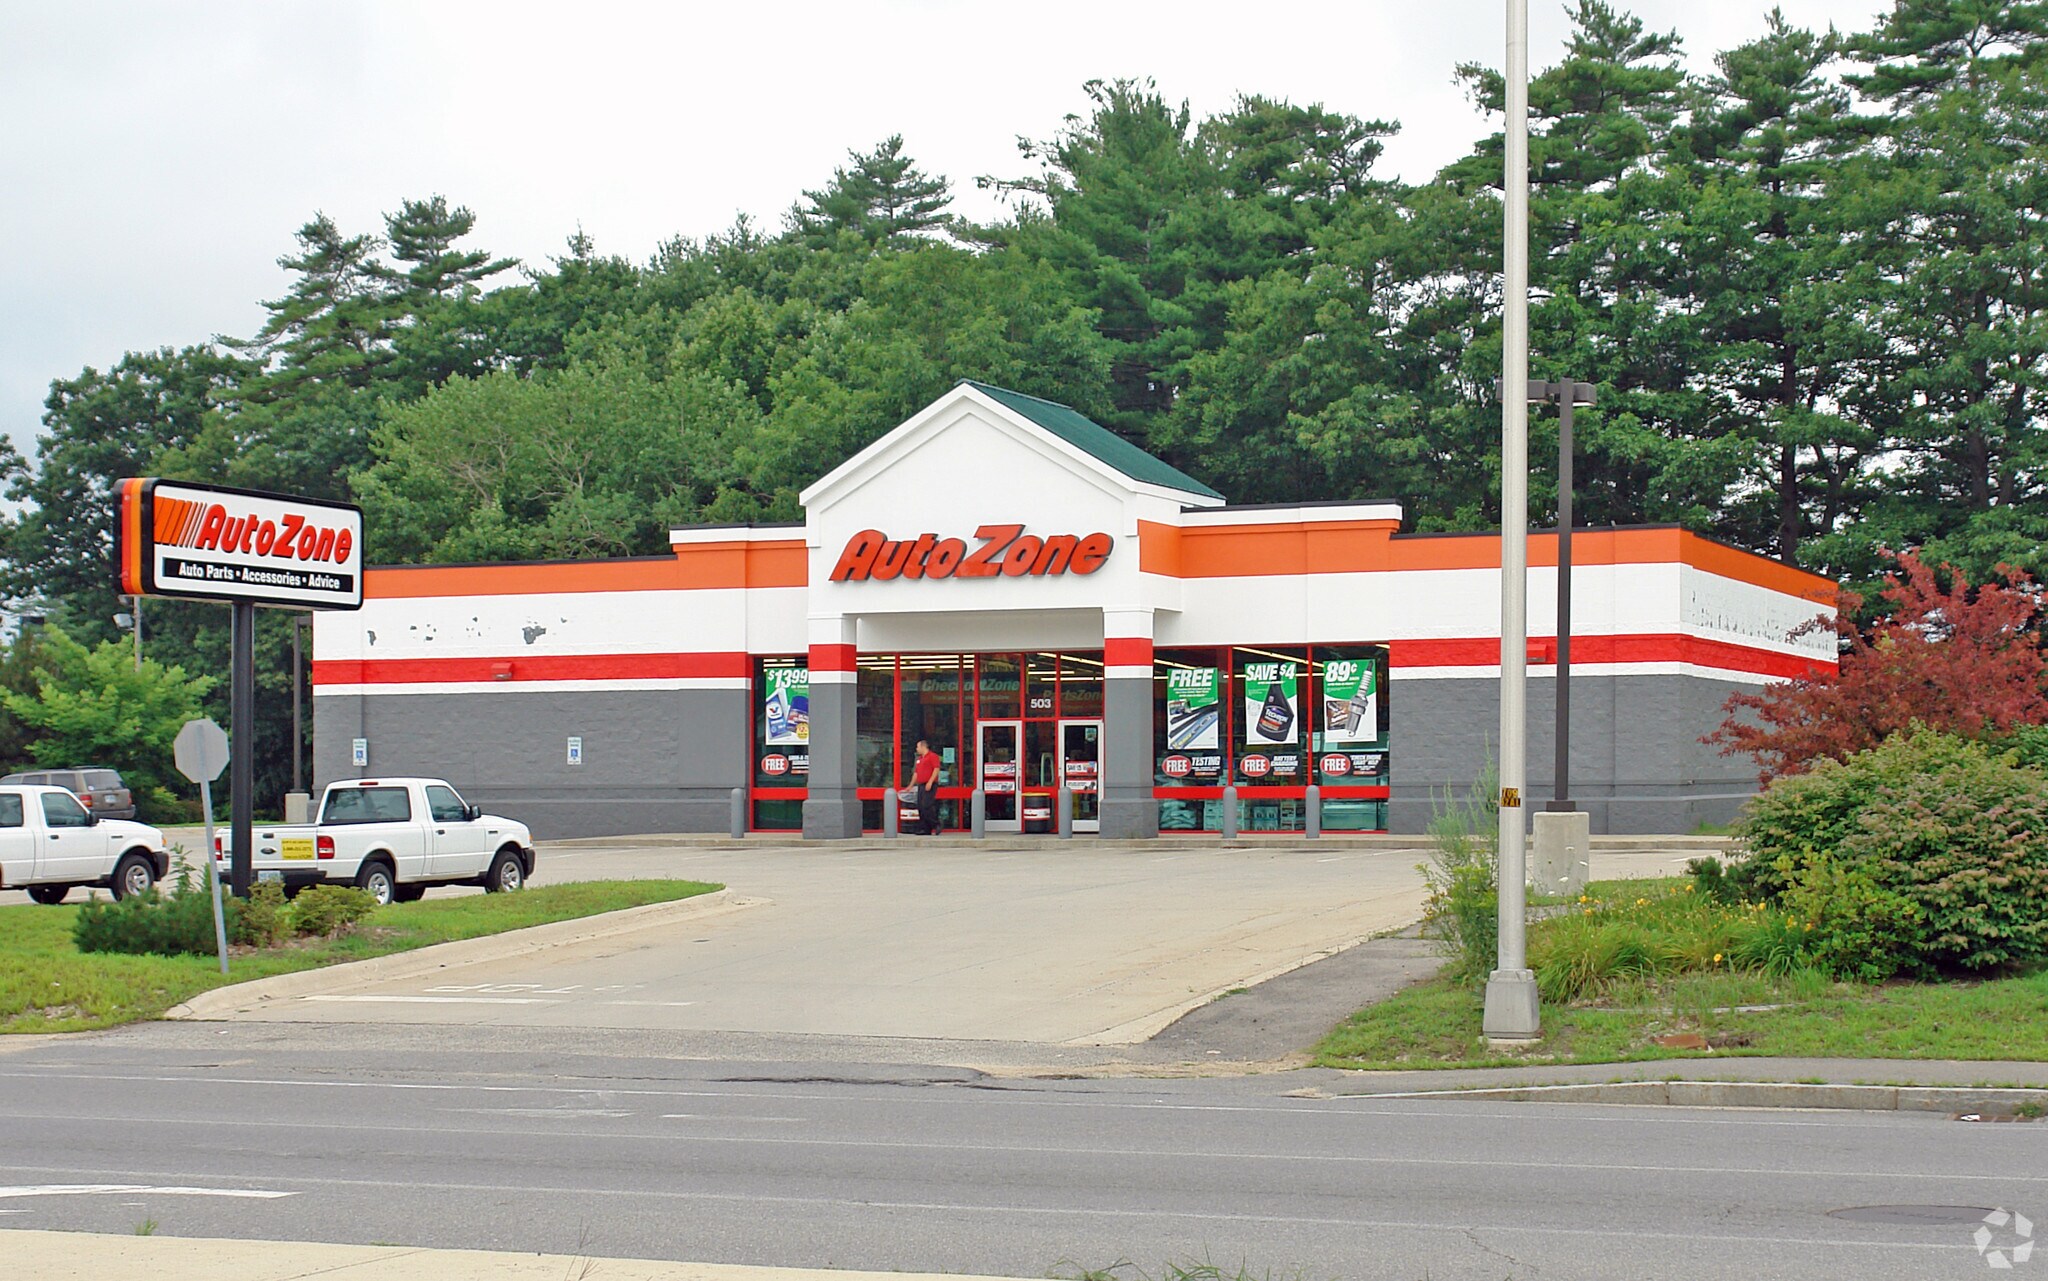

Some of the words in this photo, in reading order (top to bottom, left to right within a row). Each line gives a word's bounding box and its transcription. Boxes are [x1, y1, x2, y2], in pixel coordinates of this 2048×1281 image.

[195, 503, 354, 565] AutoZone
[828, 523, 1115, 582] AutoZone
[178, 561, 204, 579] Auto
[206, 563, 234, 581] Parts
[241, 567, 301, 587] Accessories
[308, 573, 340, 590] Advice
[1169, 668, 1214, 688] FREE
[1246, 663, 1279, 681] SAVE
[1279, 663, 1296, 680] $4
[1030, 698, 1052, 709] 503
[765, 758, 785, 771] FREE
[1166, 759, 1188, 773] FREE
[1191, 756, 1221, 766] TESTING
[1244, 759, 1266, 772] FREE
[1324, 758, 1346, 772] FREE
